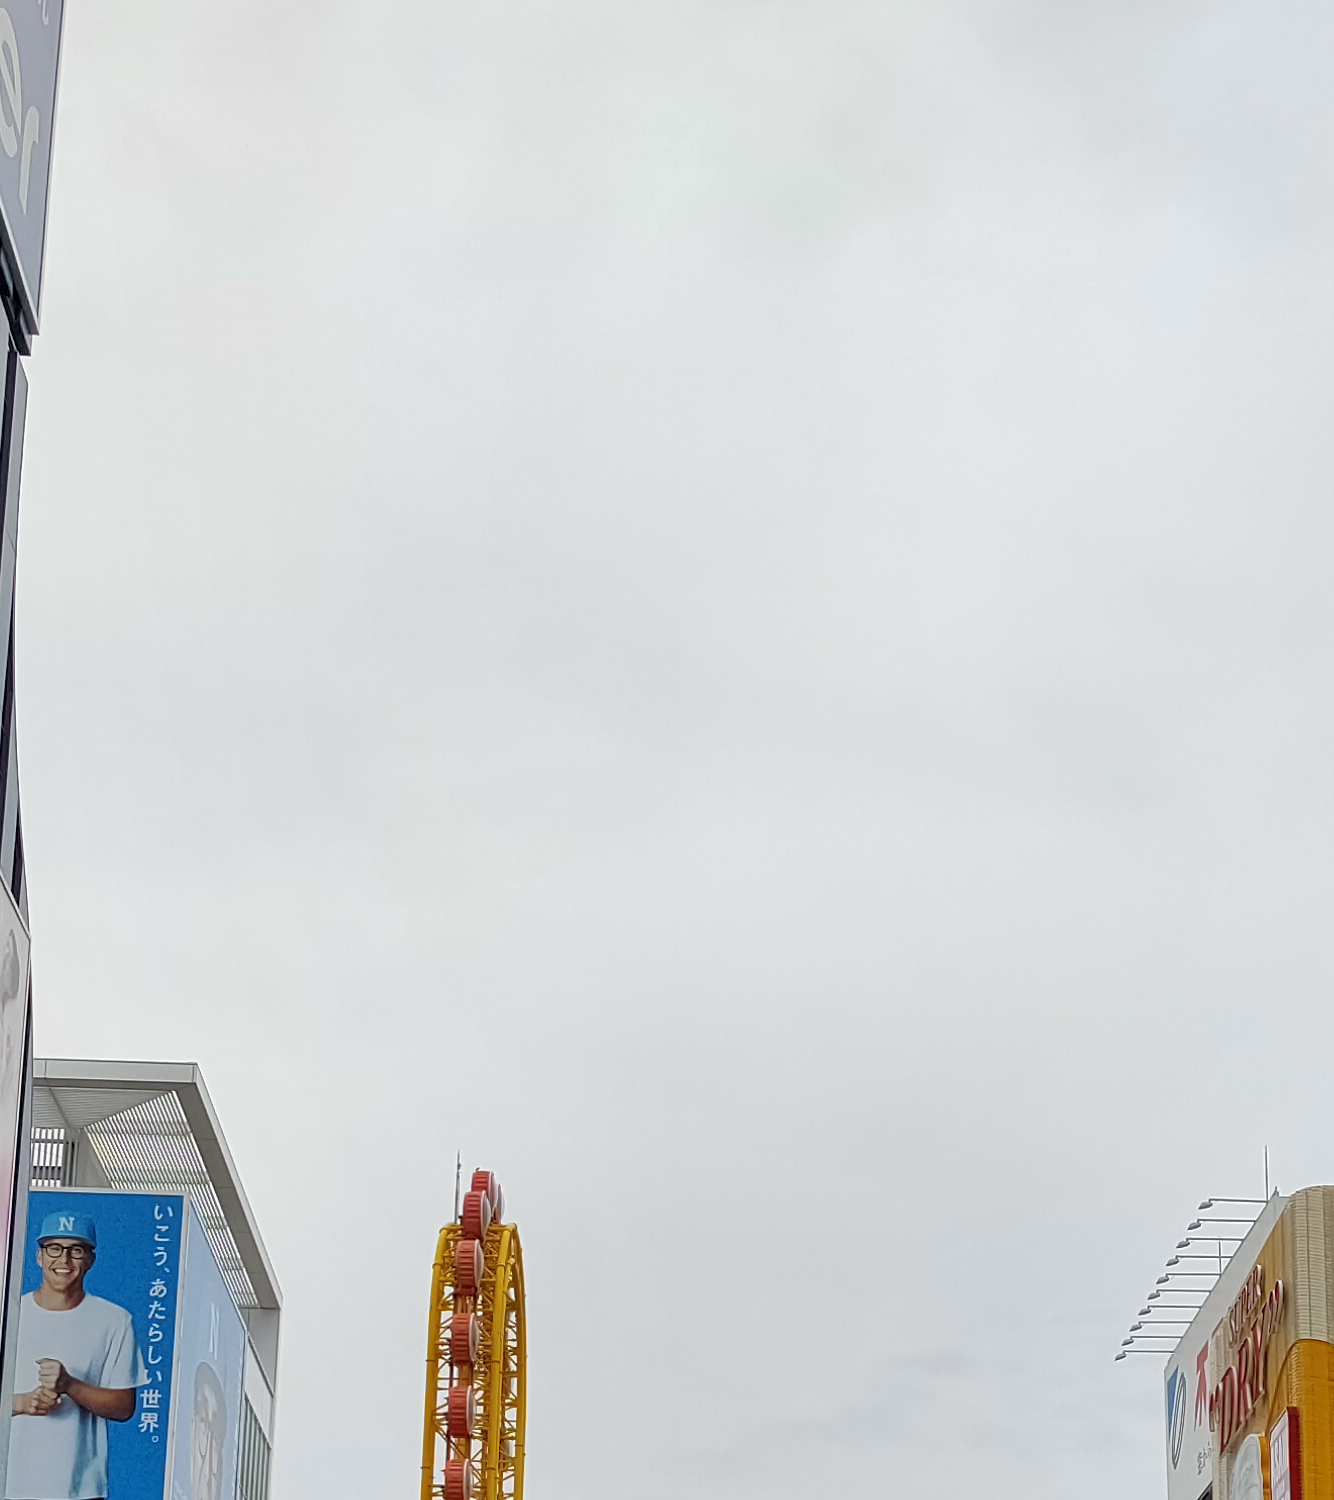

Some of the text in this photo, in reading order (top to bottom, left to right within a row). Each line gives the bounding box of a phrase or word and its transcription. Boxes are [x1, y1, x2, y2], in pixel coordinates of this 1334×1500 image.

[58, 1216, 76, 1232] N
[138, 1204, 175, 1445] いこう、あたらしい世界。
[1227, 1264, 1262, 1348] SUPER
